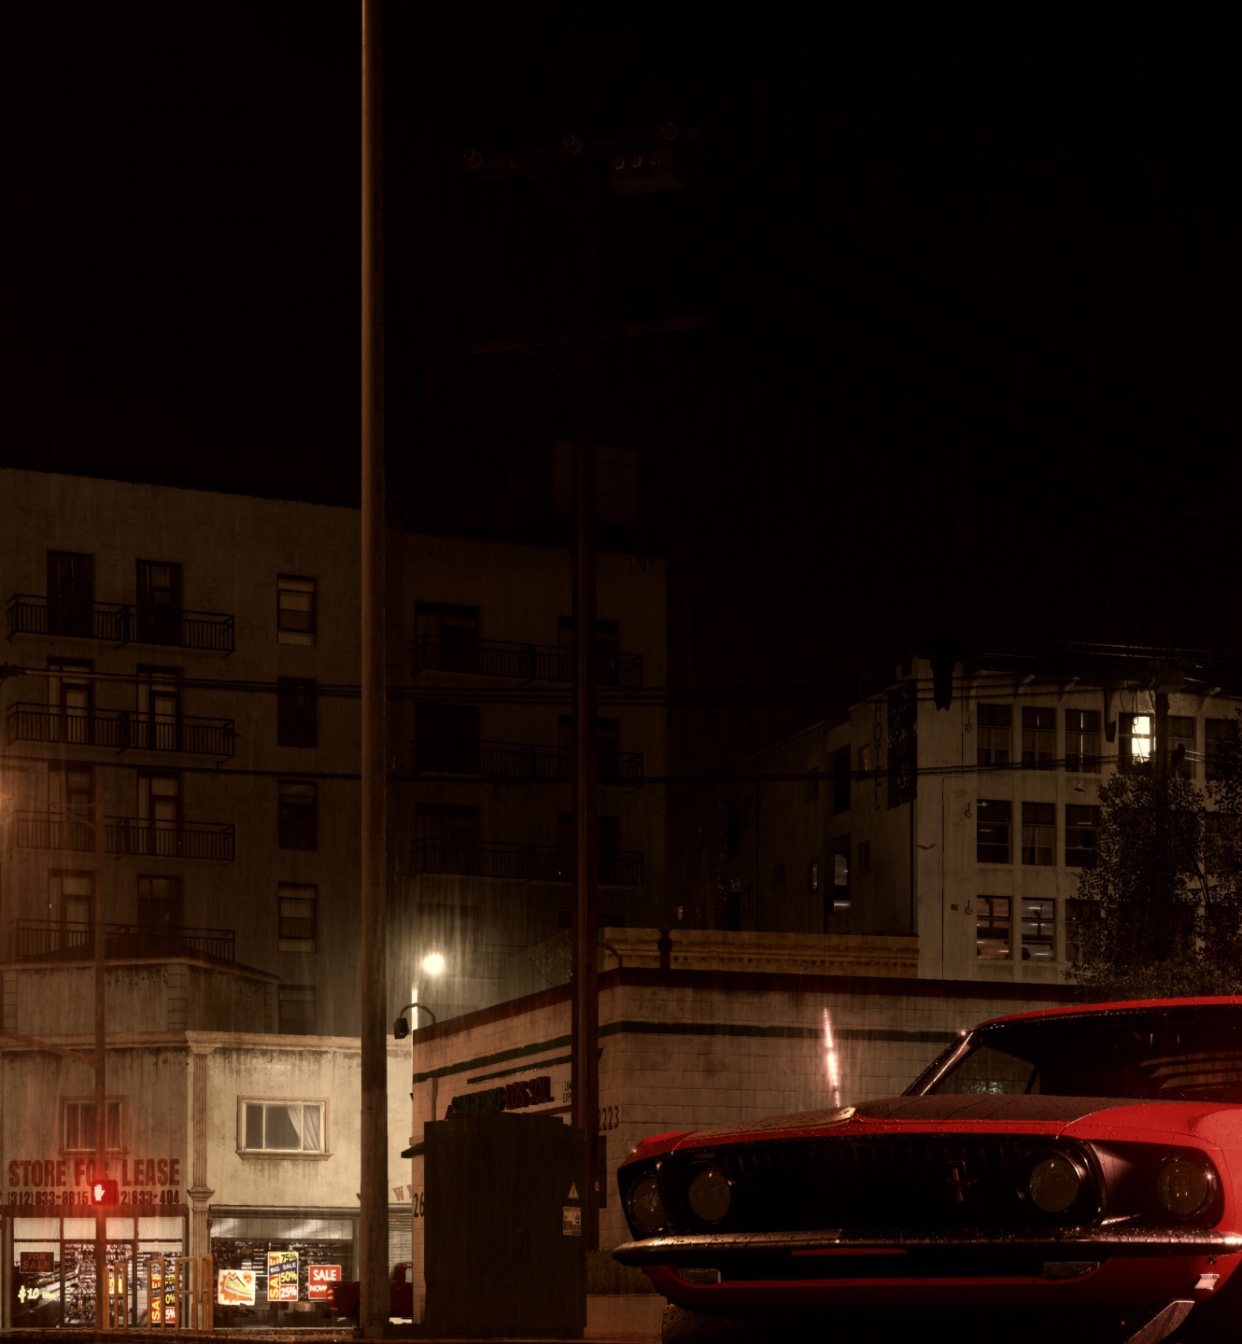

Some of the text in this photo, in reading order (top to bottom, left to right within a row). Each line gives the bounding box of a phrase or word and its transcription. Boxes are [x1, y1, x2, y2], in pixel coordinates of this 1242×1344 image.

[874, 702, 882, 810] HOTEL
[8, 1158, 181, 1187] STORE FO LEASE
[28, 1253, 46, 1261] FOR
[23, 1260, 52, 1270] SALE
[282, 1262, 297, 1270] SALE
[313, 1269, 337, 1281] SALE
